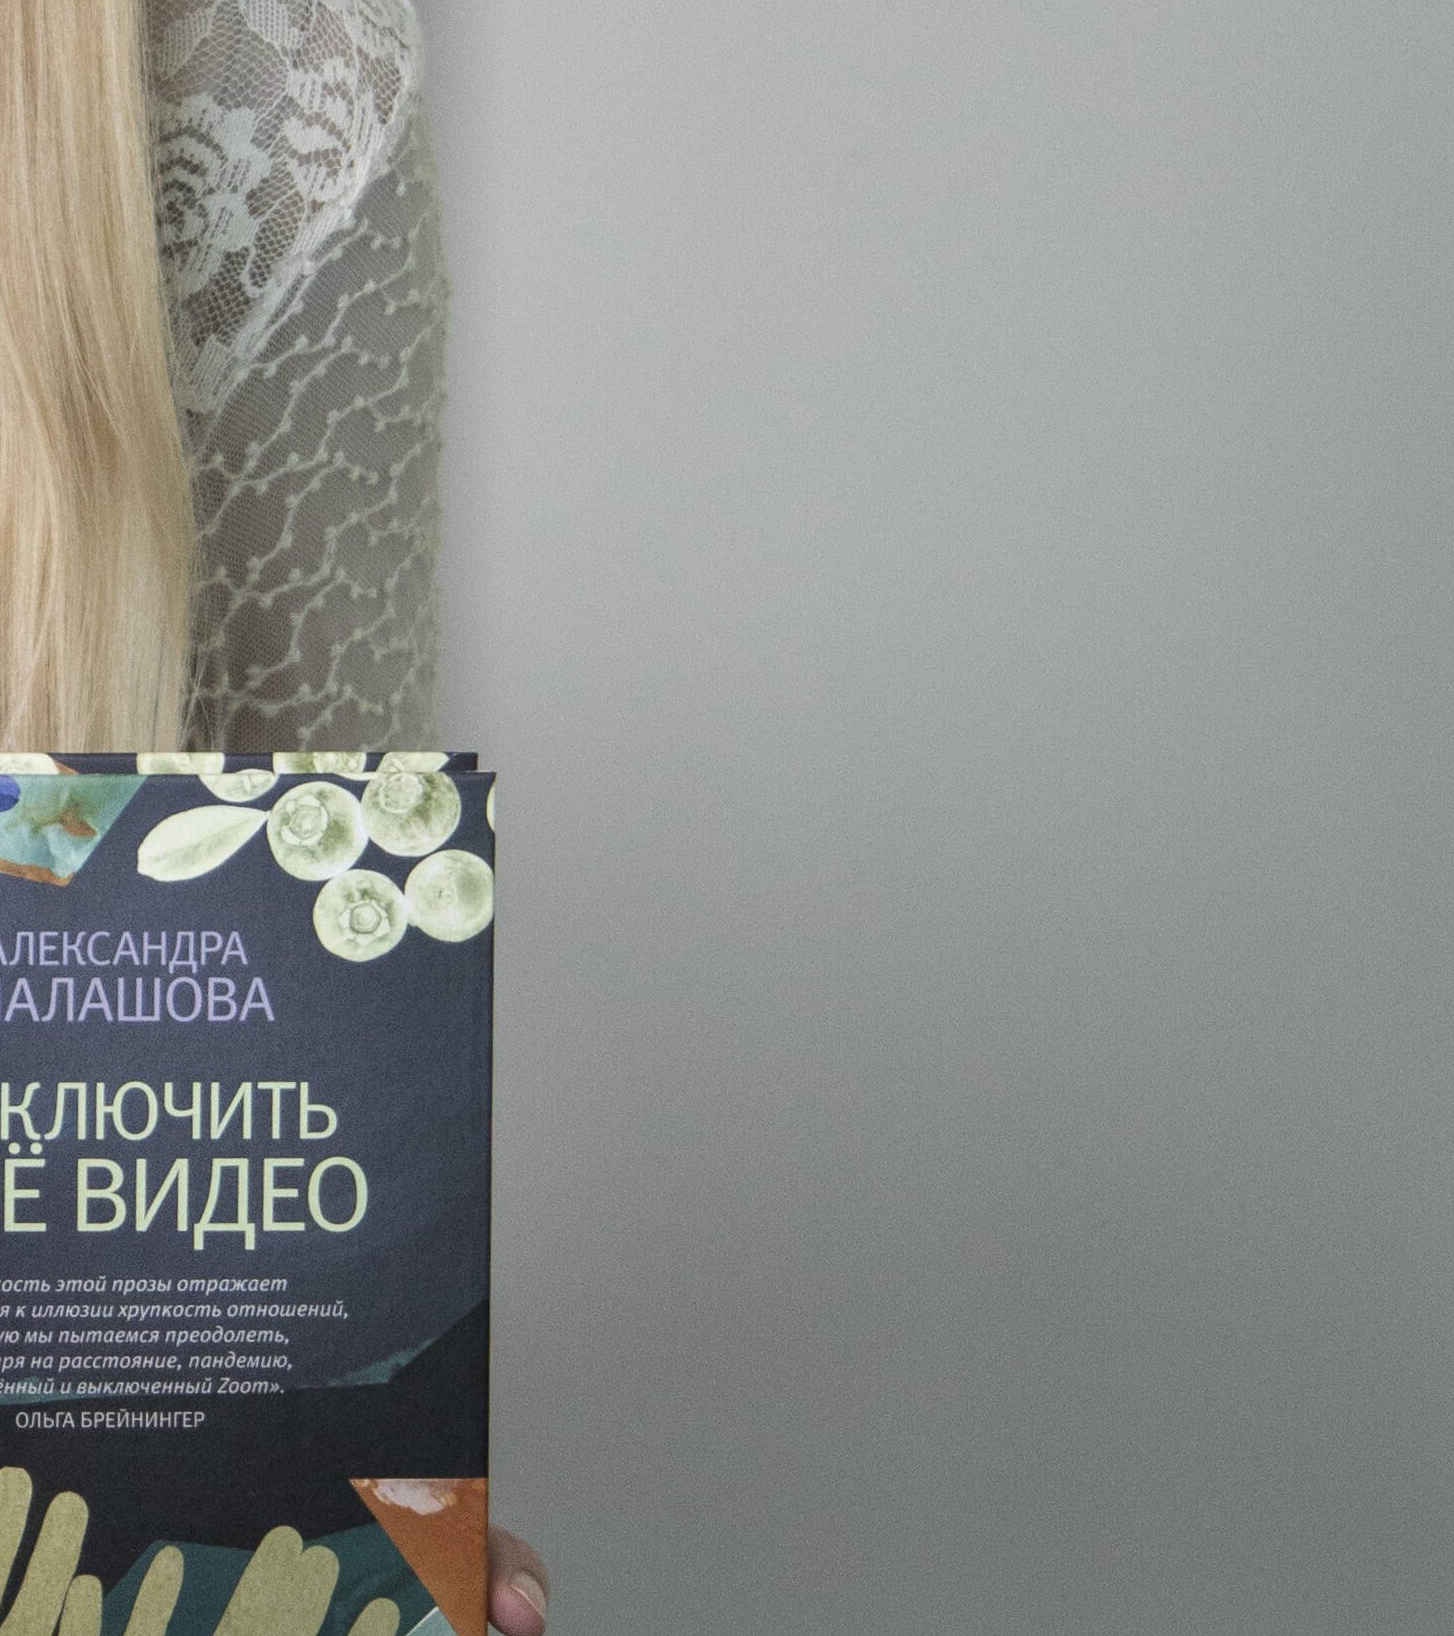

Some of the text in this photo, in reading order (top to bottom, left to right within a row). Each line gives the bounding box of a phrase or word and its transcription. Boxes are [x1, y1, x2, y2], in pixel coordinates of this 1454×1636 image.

[76, 1157, 369, 1250] ВИДЕО
[55, 1275, 107, 1292] этой
[111, 1278, 172, 1295] прозы
[176, 1278, 288, 1296] отражает
[15, 1304, 26, 1318] к
[31, 1304, 114, 1318] иллюзии
[117, 1304, 222, 1321] хрупкость
[226, 1300, 349, 1319] отношений,
[24, 1330, 53, 1344] мы
[58, 1330, 160, 1344] пытаемся
[164, 1325, 291, 1347] преодолеть,
[30, 1356, 53, 1369] на
[58, 1355, 182, 1373] расстояние,
[188, 1351, 293, 1371] пандемию,
[60, 1381, 71, 1394] и
[76, 1377, 212, 1394] выключенный
[217, 1377, 285, 1394] Zoom».
[15, 1409, 205, 1429] ОЛЬГА БРЕЙНИНГЕР
